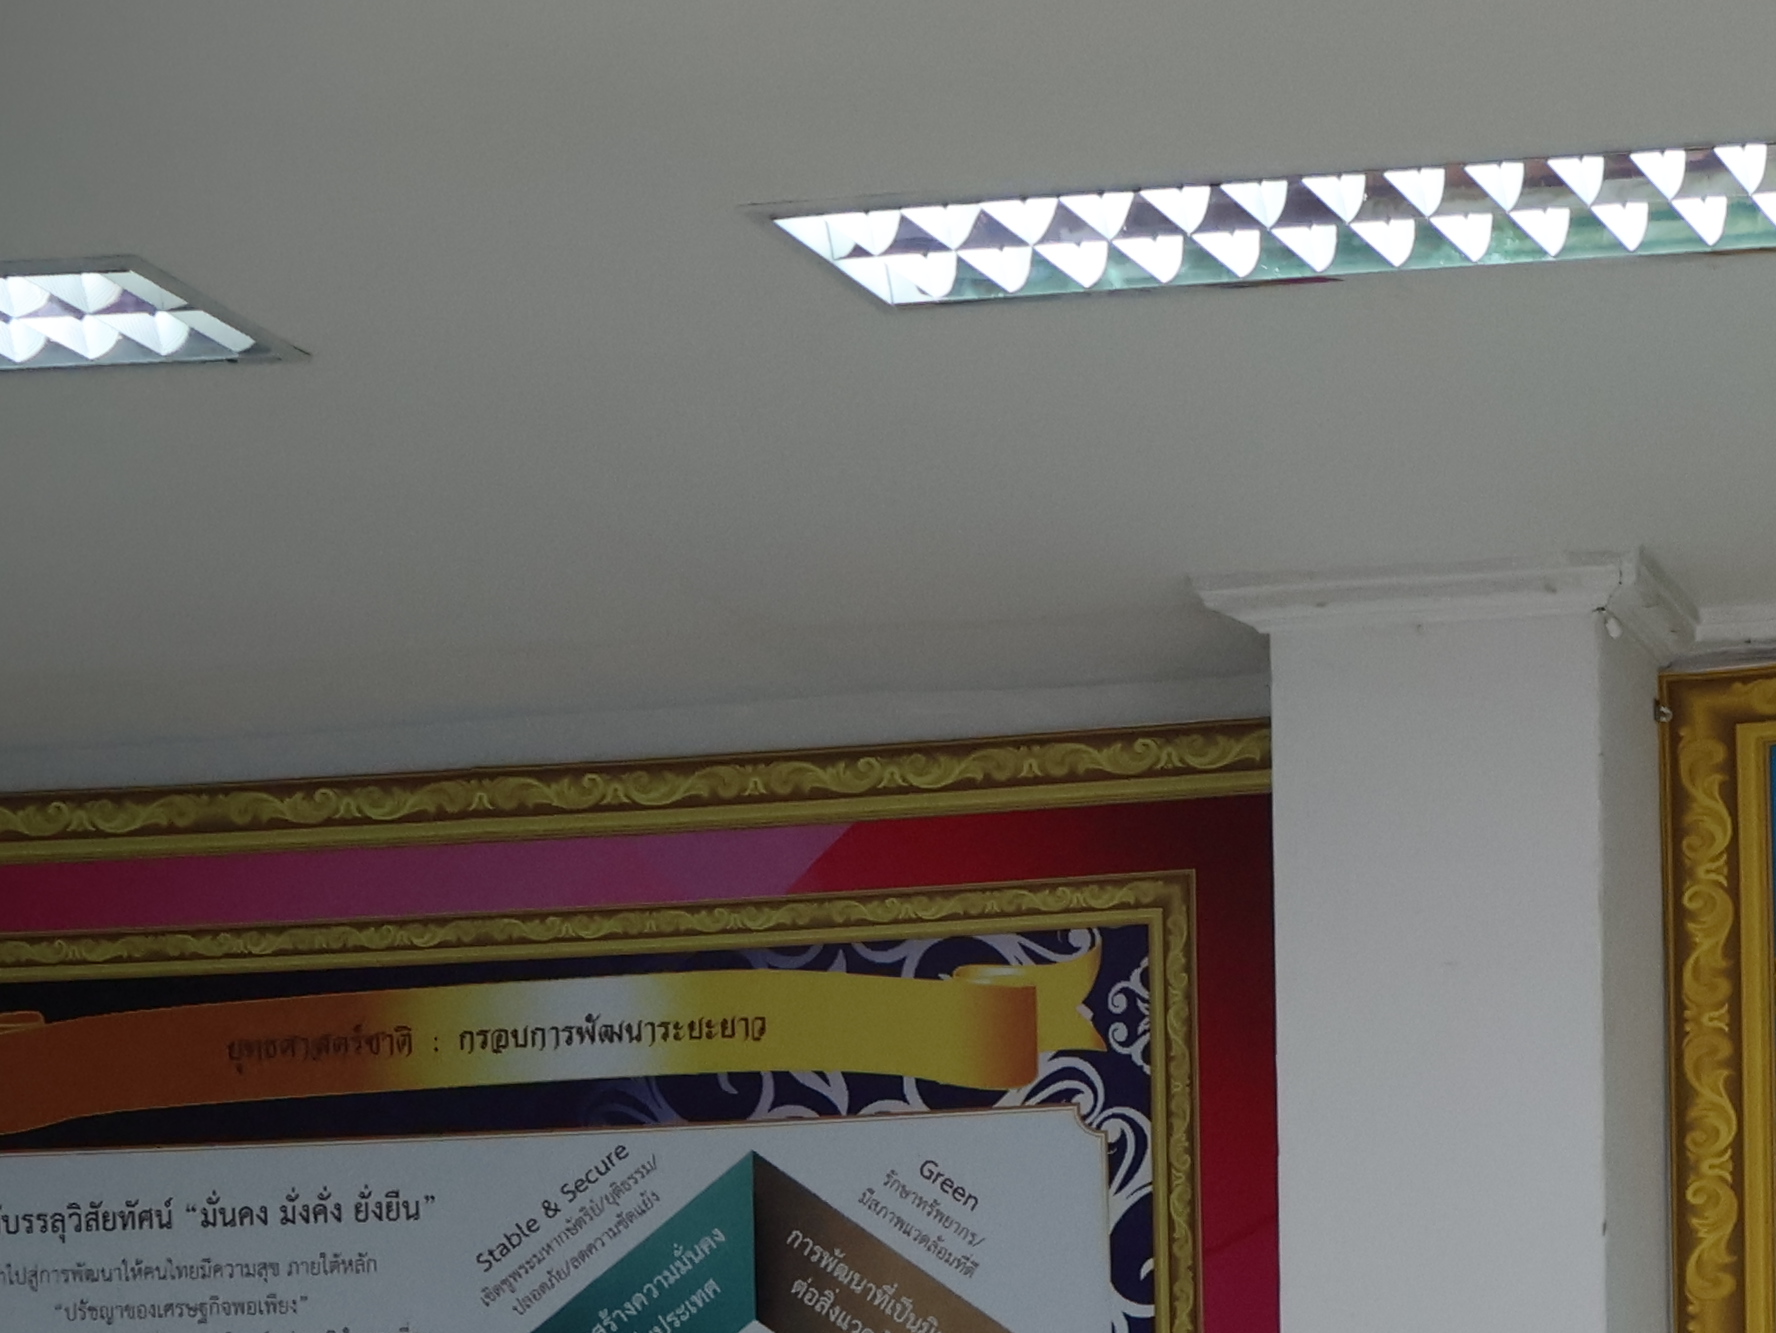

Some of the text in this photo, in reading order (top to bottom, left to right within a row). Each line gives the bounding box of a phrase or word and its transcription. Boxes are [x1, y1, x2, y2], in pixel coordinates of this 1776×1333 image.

[458, 1010, 767, 1060] กรอบการพัฒนาระยะยาว
[474, 1141, 631, 1273] Stable & Secure
[918, 1158, 980, 1213] Green
[0, 1197, 174, 1243] บรรลุวิสัยทัศน์
[279, 1186, 342, 1226] มั่งคั่ง
[286, 1251, 378, 1278] ภายใต้หลัก
